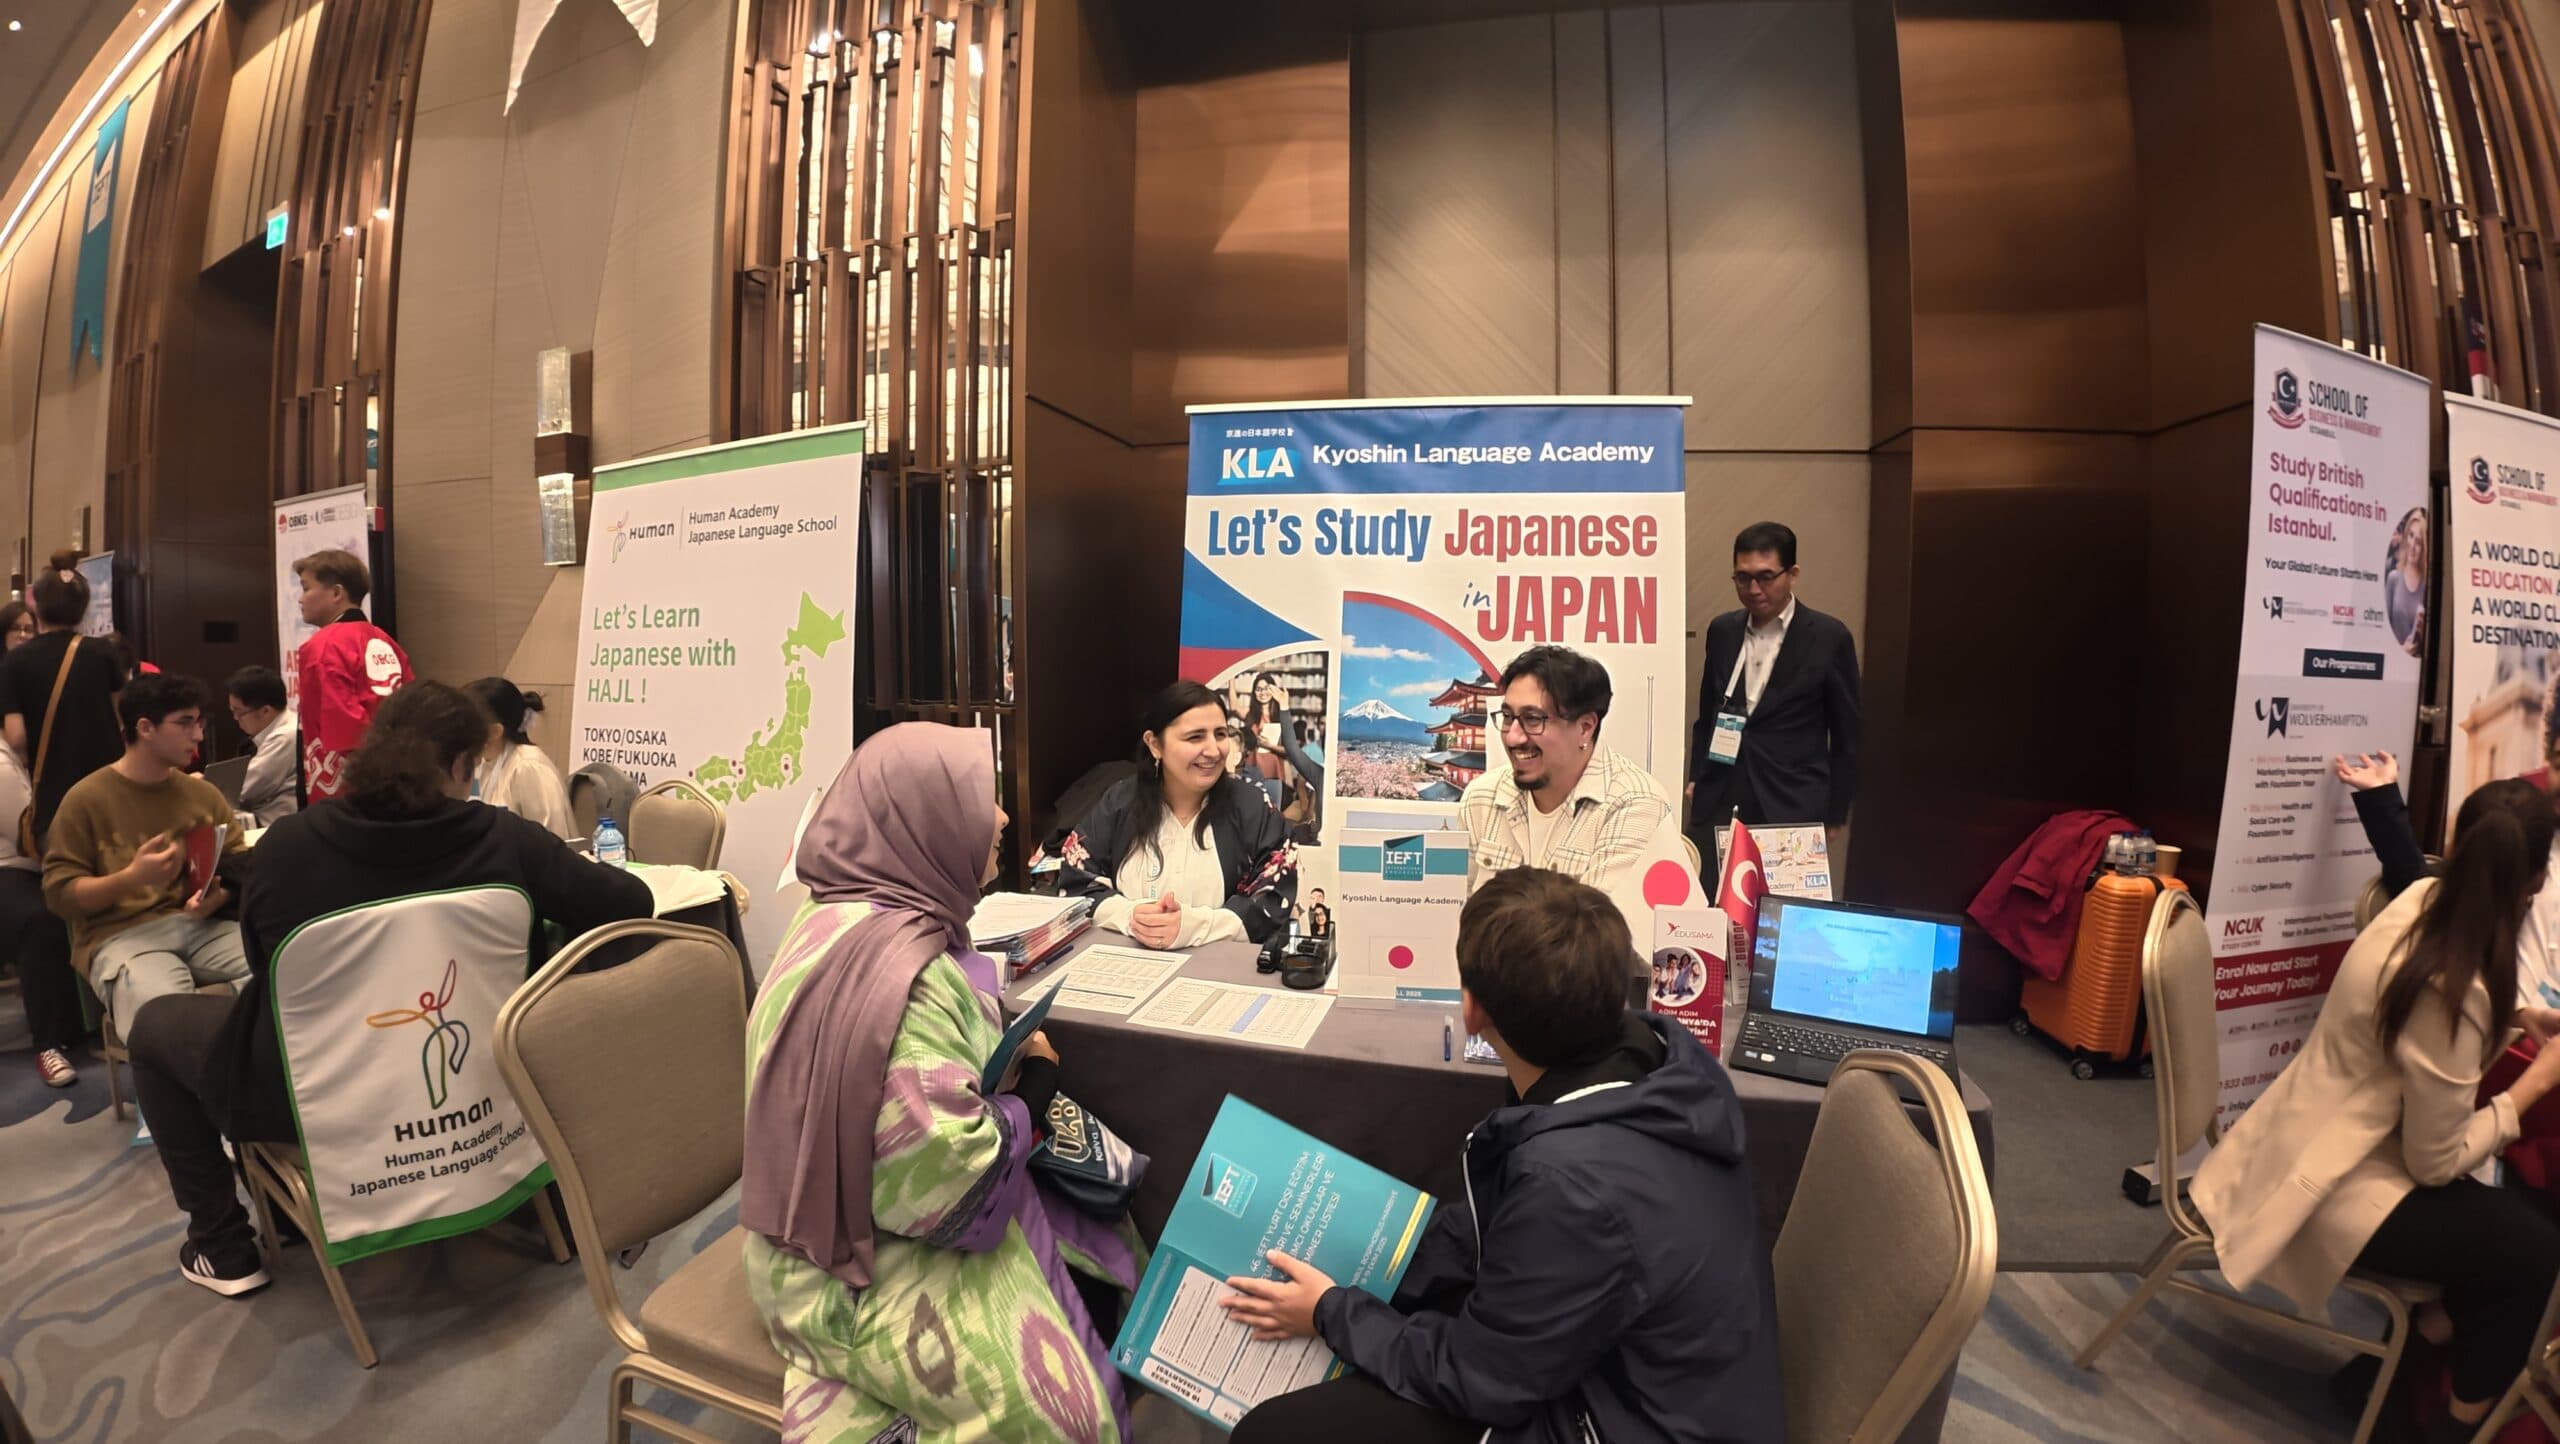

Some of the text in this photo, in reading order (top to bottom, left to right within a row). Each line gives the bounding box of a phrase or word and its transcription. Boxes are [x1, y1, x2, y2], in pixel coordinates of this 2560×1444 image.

[2308, 380, 2369, 418] SCHOOL OF
[1222, 447, 1295, 479] KLA
[1313, 441, 1655, 467] Kyoshin Language Academy
[2270, 452, 2364, 489] Study British
[689, 504, 780, 525] Human Academy
[2269, 482, 2387, 522] Qualifications in
[629, 523, 675, 540] Human
[688, 515, 837, 546] Japanese Language School
[1208, 508, 1658, 562] Let's Study Japanese
[2268, 513, 2337, 542] Istanbul.
[2265, 557, 2287, 570] Your
[2470, 541, 2560, 569] A WORLD CL
[2471, 568, 2553, 595] EDUCATION
[593, 602, 700, 631] Let's Learn
[1463, 576, 1658, 644] in JAPAN
[2472, 597, 2483, 615] A
[2488, 598, 2541, 621] WORLD
[589, 638, 736, 673] Japanese with
[587, 678, 646, 704] HAJL !
[2289, 713, 2368, 727] WOLVERHAMPTON
[584, 728, 667, 746] TOKYO/OSAKA
[583, 747, 677, 768] KOBE/FUKUOKA
[1386, 850, 1423, 865] IEFT
[1807, 875, 1827, 887] KLA
[1342, 894, 1465, 906] Kyoshin Language Academy
[2224, 916, 2265, 937] NCUK
[2216, 954, 2320, 980] Enrol Now and Start
[2240, 979, 2284, 997] Journey
[394, 1096, 493, 1142] Human
[384, 1120, 504, 1169] Human Academy
[349, 1122, 527, 1197] Japanese Language School
[1302, 1184, 1327, 1234] OKULLAR
[1323, 1167, 1335, 1186] VE
[1267, 1207, 1283, 1236] YURT
[1283, 1219, 1294, 1236] VE
